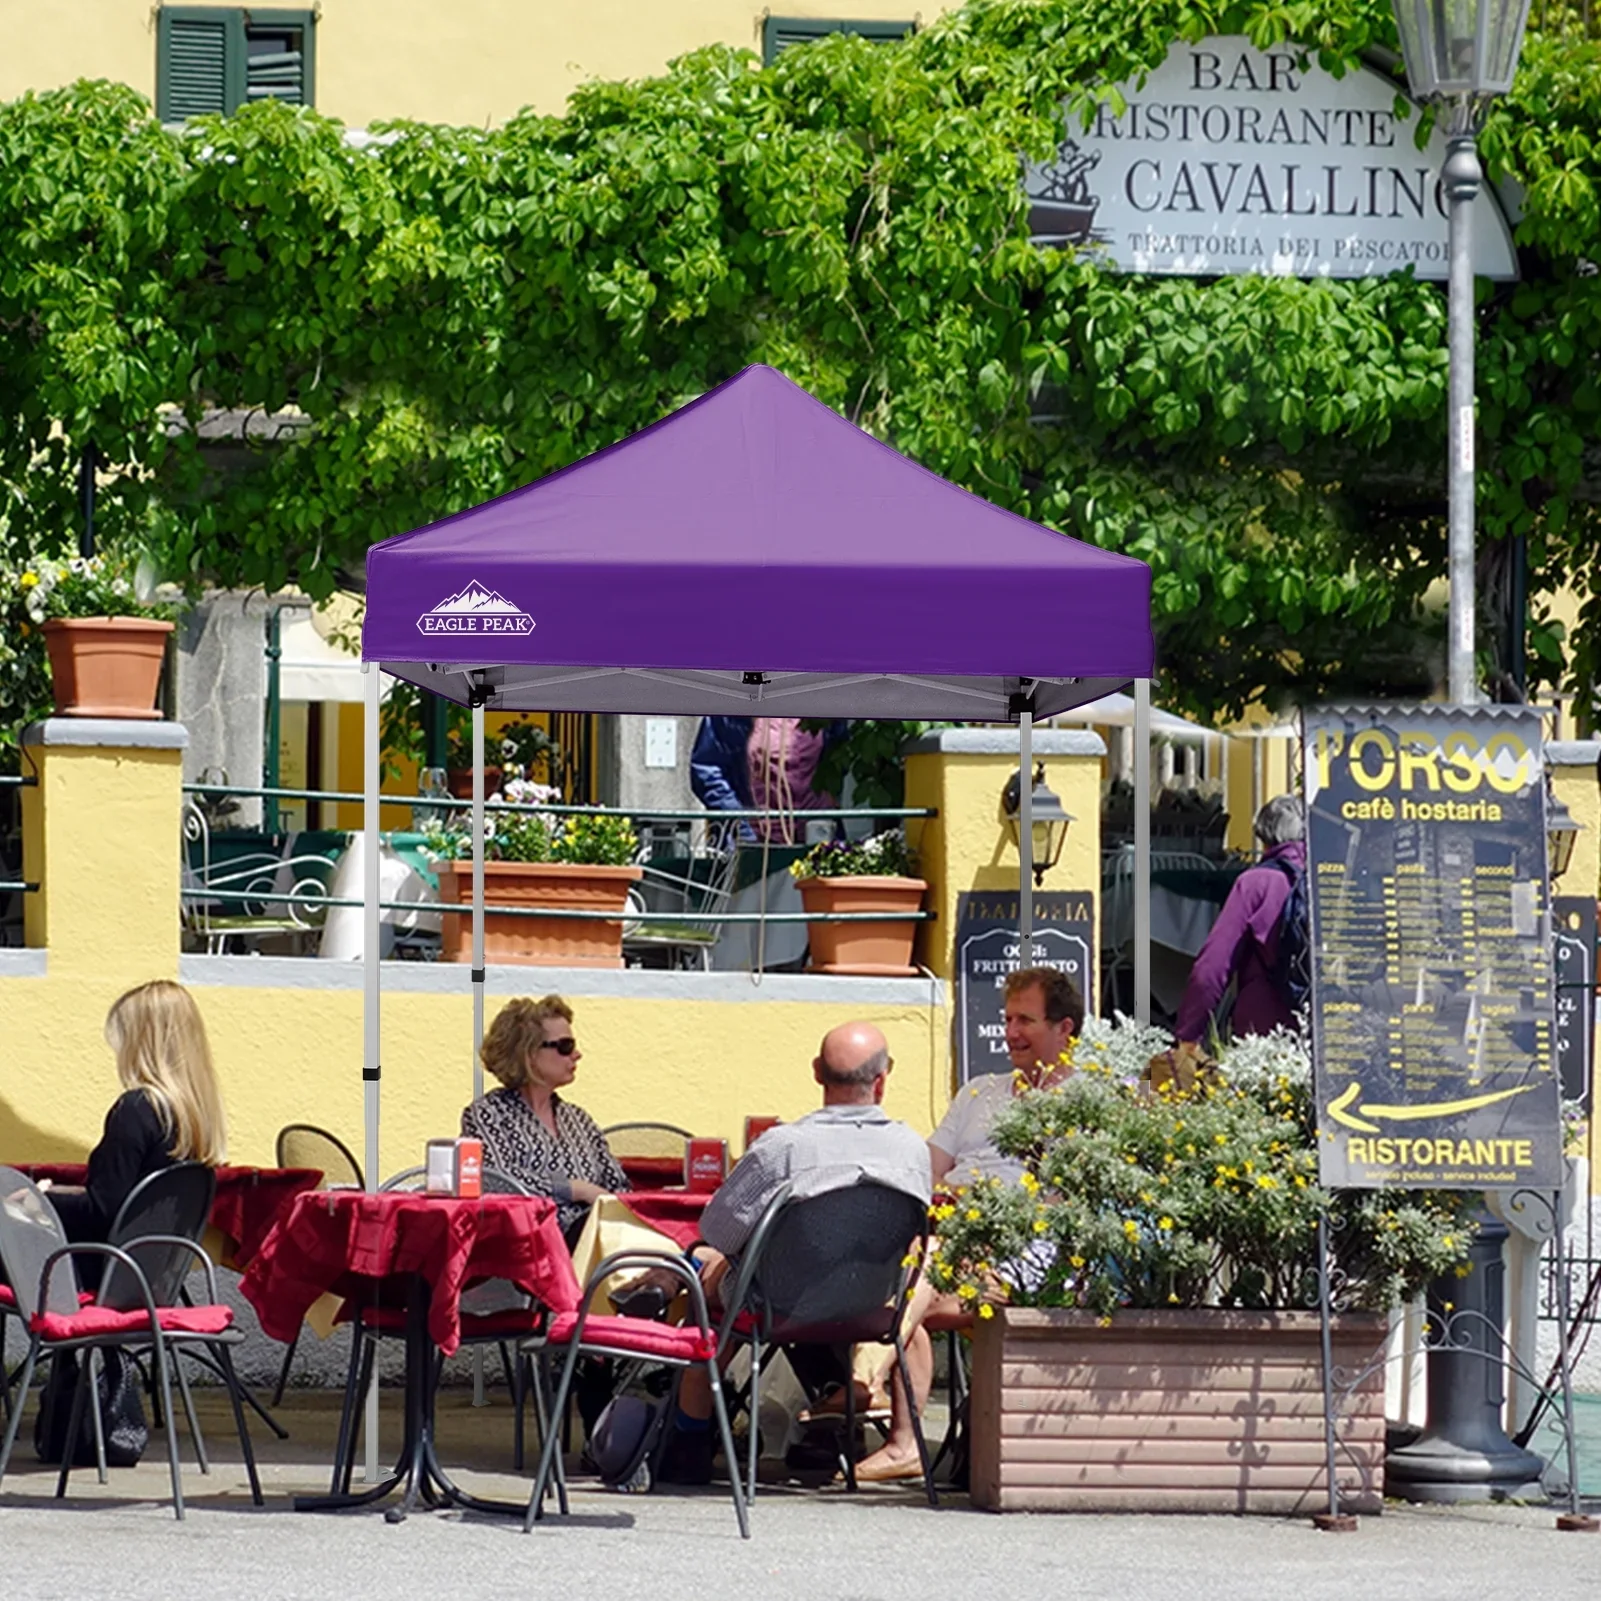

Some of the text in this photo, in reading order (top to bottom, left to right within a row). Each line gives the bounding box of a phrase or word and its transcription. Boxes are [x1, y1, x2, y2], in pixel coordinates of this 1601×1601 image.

[1189, 52, 1301, 92] BAR
[1094, 102, 1396, 147] RISTORANTE
[1127, 232, 1265, 257] TRATTORIA
[1278, 236, 1321, 258] DEI
[424, 617, 477, 632] EAGLE
[1341, 796, 1502, 821] cafè hostaria
[1347, 1137, 1533, 1167] RISTORANTE
